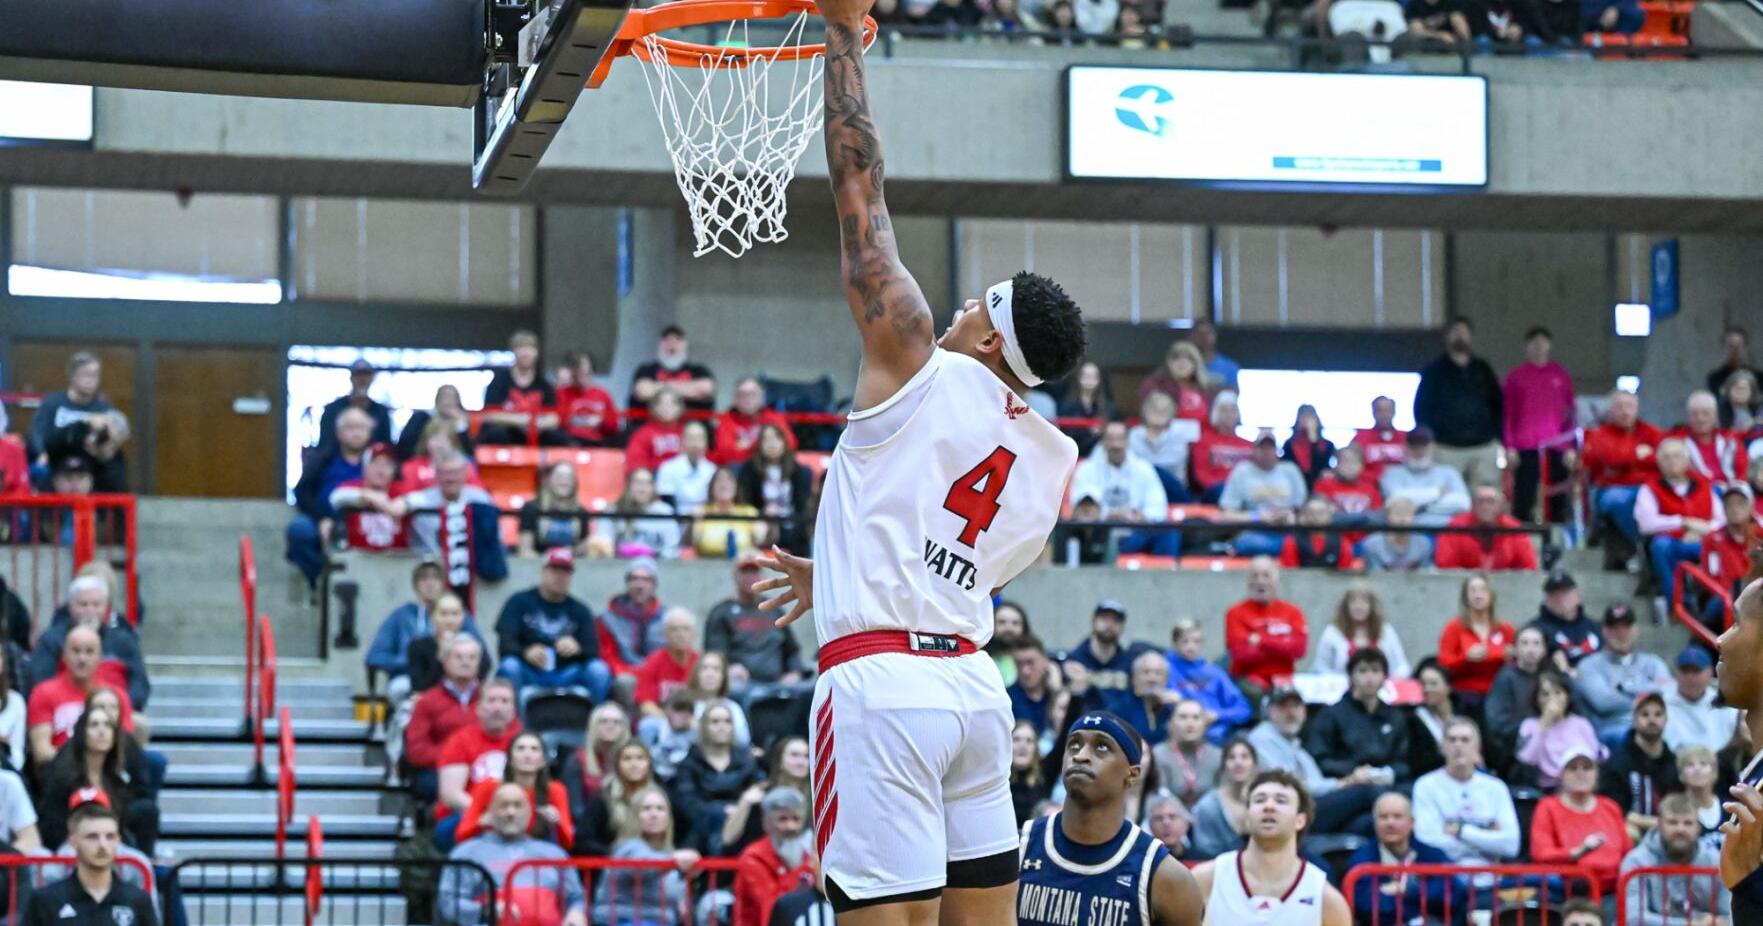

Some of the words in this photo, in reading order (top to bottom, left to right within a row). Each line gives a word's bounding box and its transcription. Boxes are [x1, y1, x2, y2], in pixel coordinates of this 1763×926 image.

[943, 445, 1017, 549] 4
[1019, 883, 1082, 926] MONTANA
[1087, 895, 1131, 926] STATE
